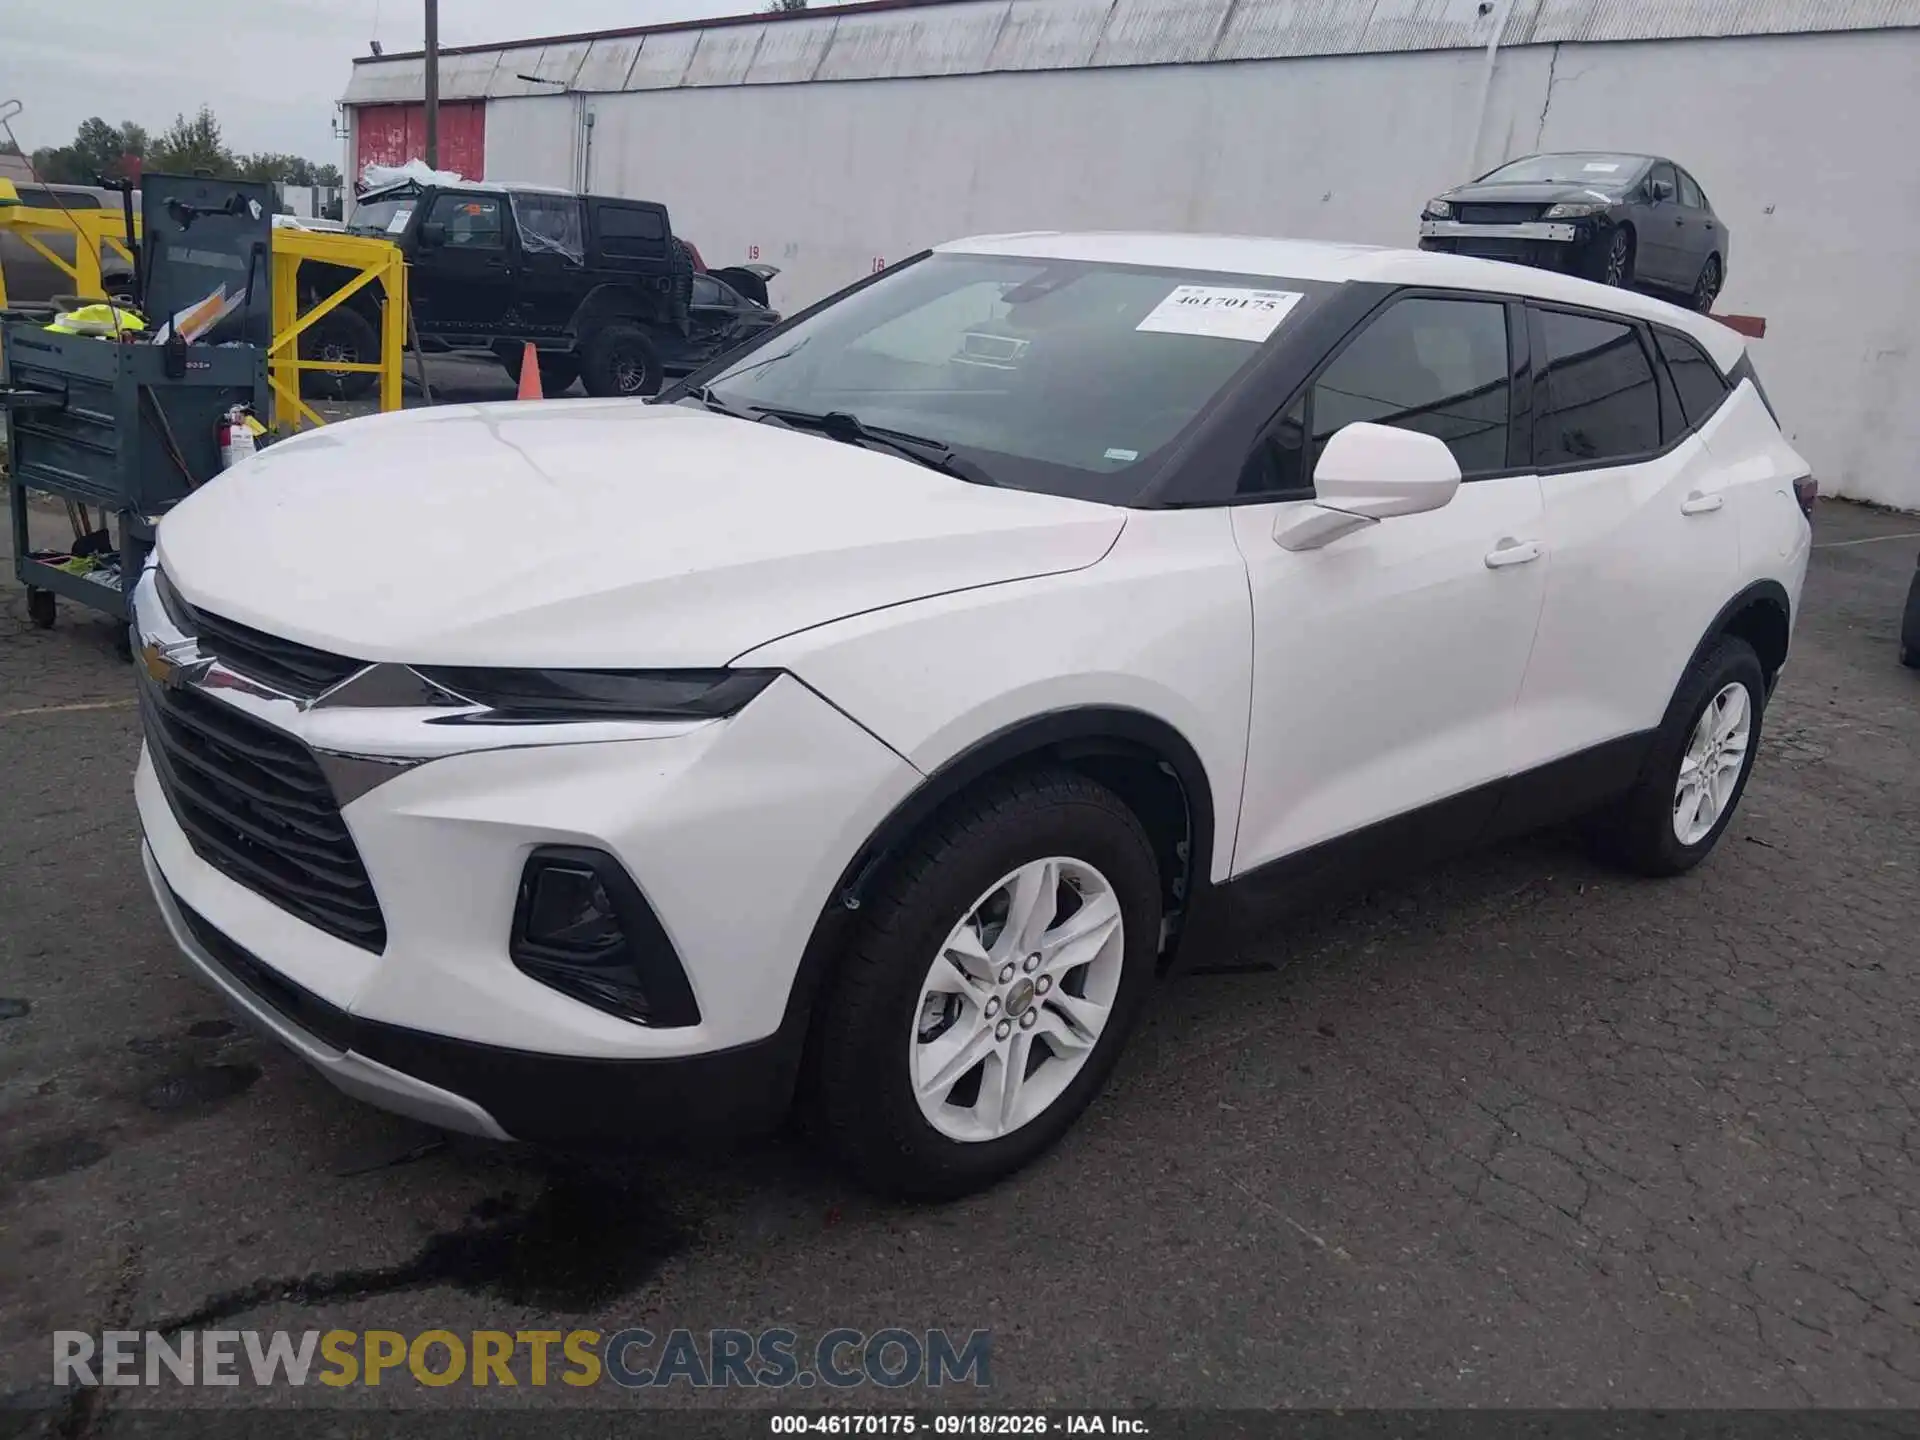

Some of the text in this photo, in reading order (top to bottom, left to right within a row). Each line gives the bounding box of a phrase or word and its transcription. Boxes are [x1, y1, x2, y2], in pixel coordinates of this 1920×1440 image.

[749, 245, 760, 260] 19
[872, 256, 885, 273] 18
[1176, 296, 1279, 311] 46170175
